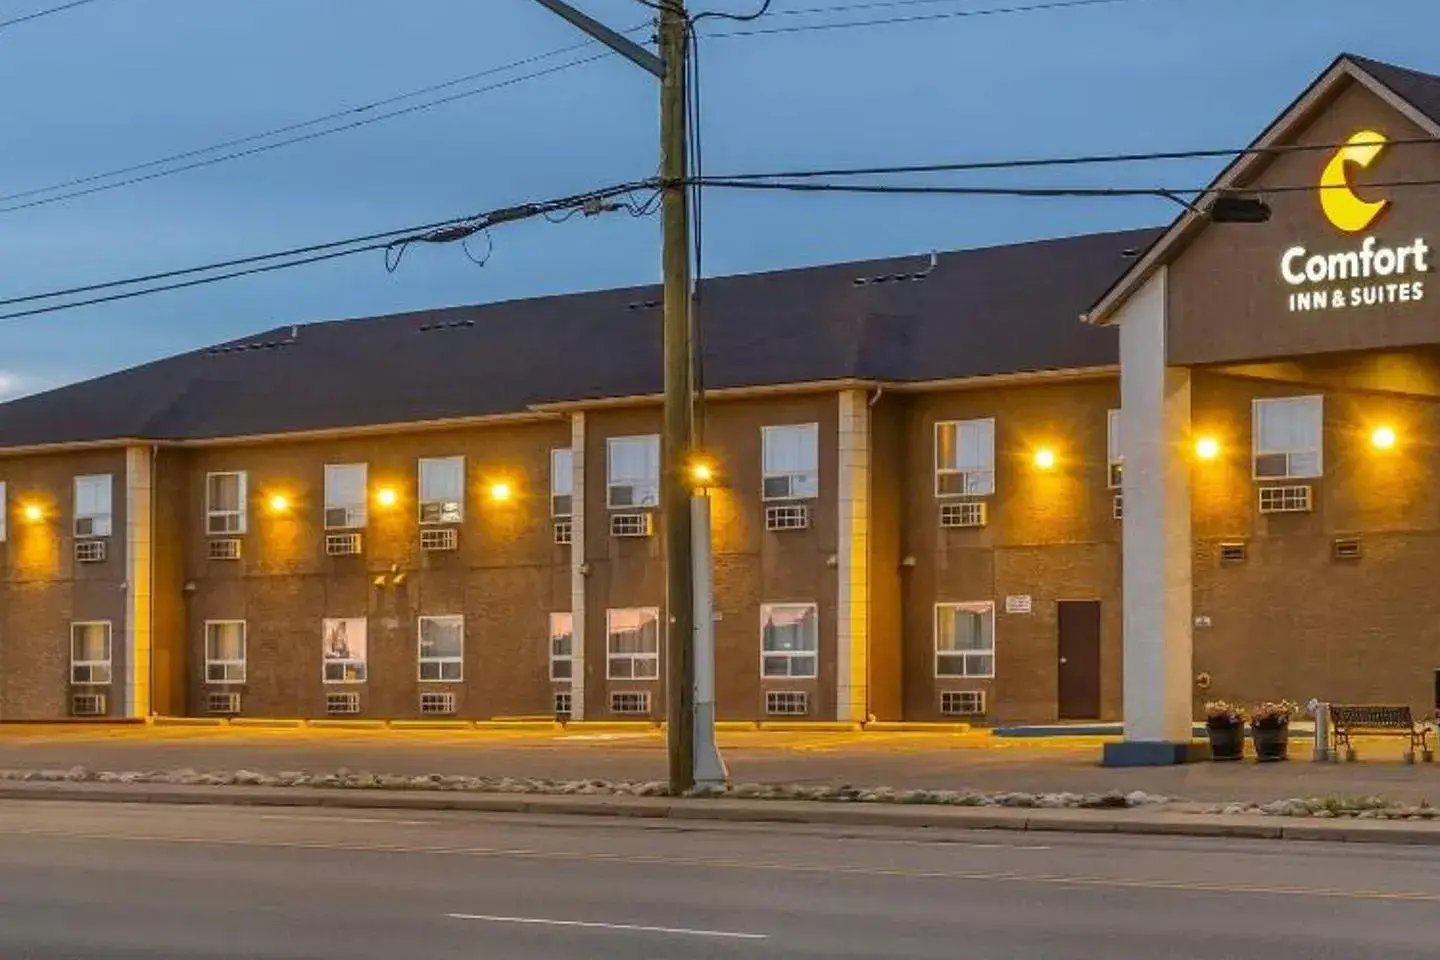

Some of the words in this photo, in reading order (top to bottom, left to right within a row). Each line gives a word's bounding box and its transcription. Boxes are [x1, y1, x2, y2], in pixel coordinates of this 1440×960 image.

[1280, 236, 1429, 285] Comfort
[1289, 291, 1328, 312] INN
[1331, 290, 1346, 309] &
[1350, 282, 1425, 307] SUITES
